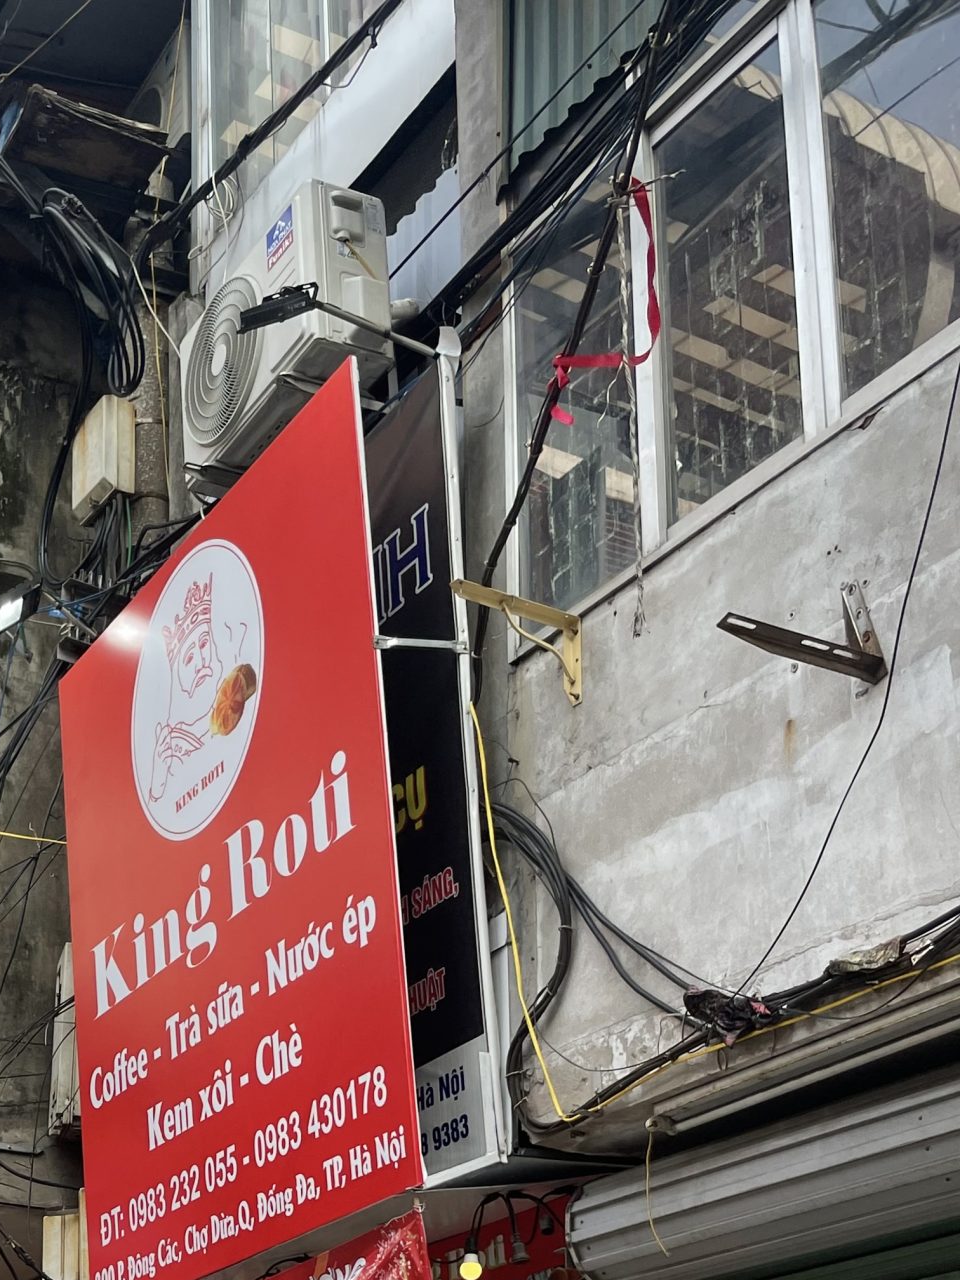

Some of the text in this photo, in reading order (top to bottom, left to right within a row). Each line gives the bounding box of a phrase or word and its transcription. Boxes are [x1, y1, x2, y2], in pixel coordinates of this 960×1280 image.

[174, 760, 226, 814] KING ROTI
[90, 750, 358, 1021] King Roti
[89, 1047, 149, 1110] Coffee
[165, 1004, 202, 1062] Trà
[207, 980, 245, 1036] sữa
[264, 921, 335, 997] Nước
[342, 894, 376, 949] ép
[409, 966, 446, 1016] HUẬT
[146, 1023, 303, 1151] Kem xôi Chè
[417, 1065, 465, 1112] Hà Nội
[421, 1113, 469, 1158] 8 9383
[100, 1065, 388, 1247] ĐT: 0983 232 055 0983 430178
[157, 1238, 183, 1268] Các,
[184, 1224, 209, 1254] Chợ
[256, 1184, 294, 1223] Đống
[295, 1173, 320, 1206] Đa,
[348, 1144, 372, 1181] Hà
[374, 1125, 407, 1169] Nội
